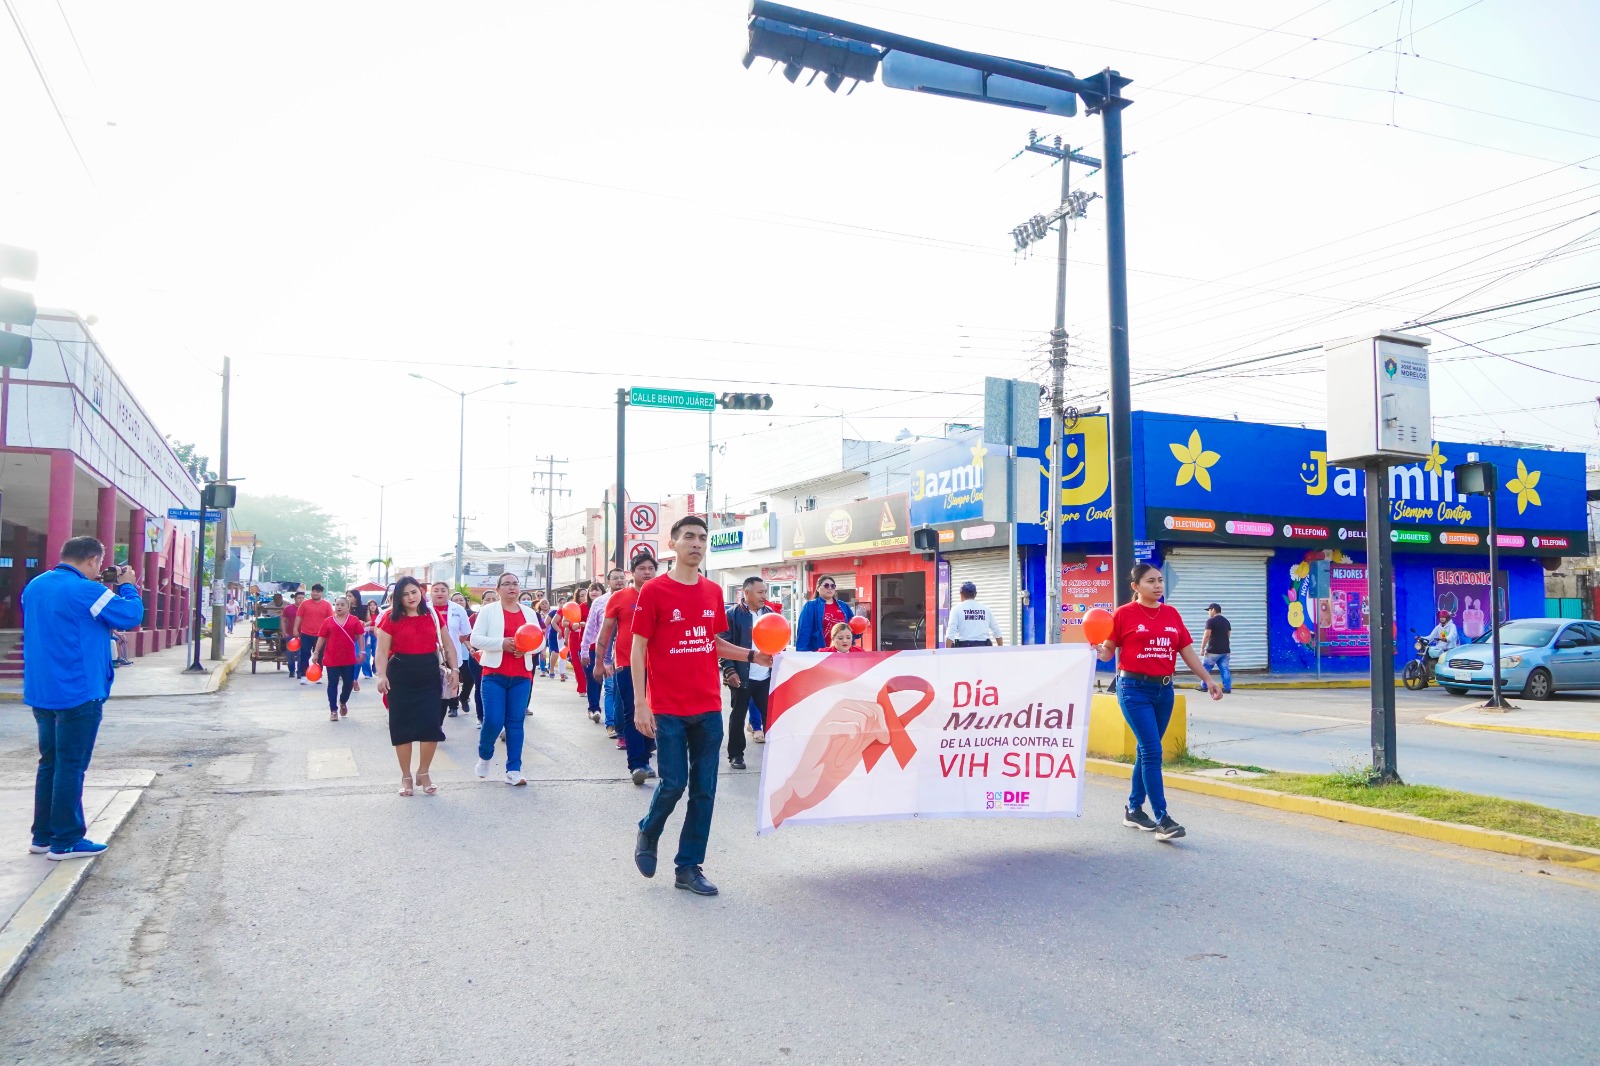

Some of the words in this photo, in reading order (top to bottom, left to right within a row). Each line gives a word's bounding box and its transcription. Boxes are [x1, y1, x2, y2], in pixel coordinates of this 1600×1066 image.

[1401, 369, 1427, 380] MORELOS
[632, 392, 656, 403] CALLE
[657, 394, 685, 405] BENITO
[685, 395, 714, 407] JUÁREZ
[914, 463, 984, 501] Jazmi
[1306, 450, 1468, 503] Jamin
[1437, 501, 1472, 525] Contigo
[1175, 519, 1213, 530] ELECTRÓNICA
[1294, 527, 1328, 537] TELEFONÍA
[1348, 530, 1367, 538] BELL
[1399, 533, 1430, 542] JUGUETES
[1448, 534, 1478, 544] ELECTRÓNICA
[1540, 537, 1567, 546] TELEFONÍA
[1332, 568, 1363, 579] MEJORES
[1436, 570, 1492, 586] ELECTRONIC
[692, 626, 707, 637] VIH
[952, 679, 999, 708] Día
[942, 702, 1075, 731] Mundial
[940, 738, 956, 748] DE
[958, 737, 972, 748] LA
[974, 736, 1009, 747] LUCHA
[1012, 736, 1059, 748] CONTRA
[1062, 737, 1075, 748] EL
[939, 752, 989, 778] VIH
[1001, 752, 1077, 779] SIDA
[1003, 791, 1030, 804] DIF
